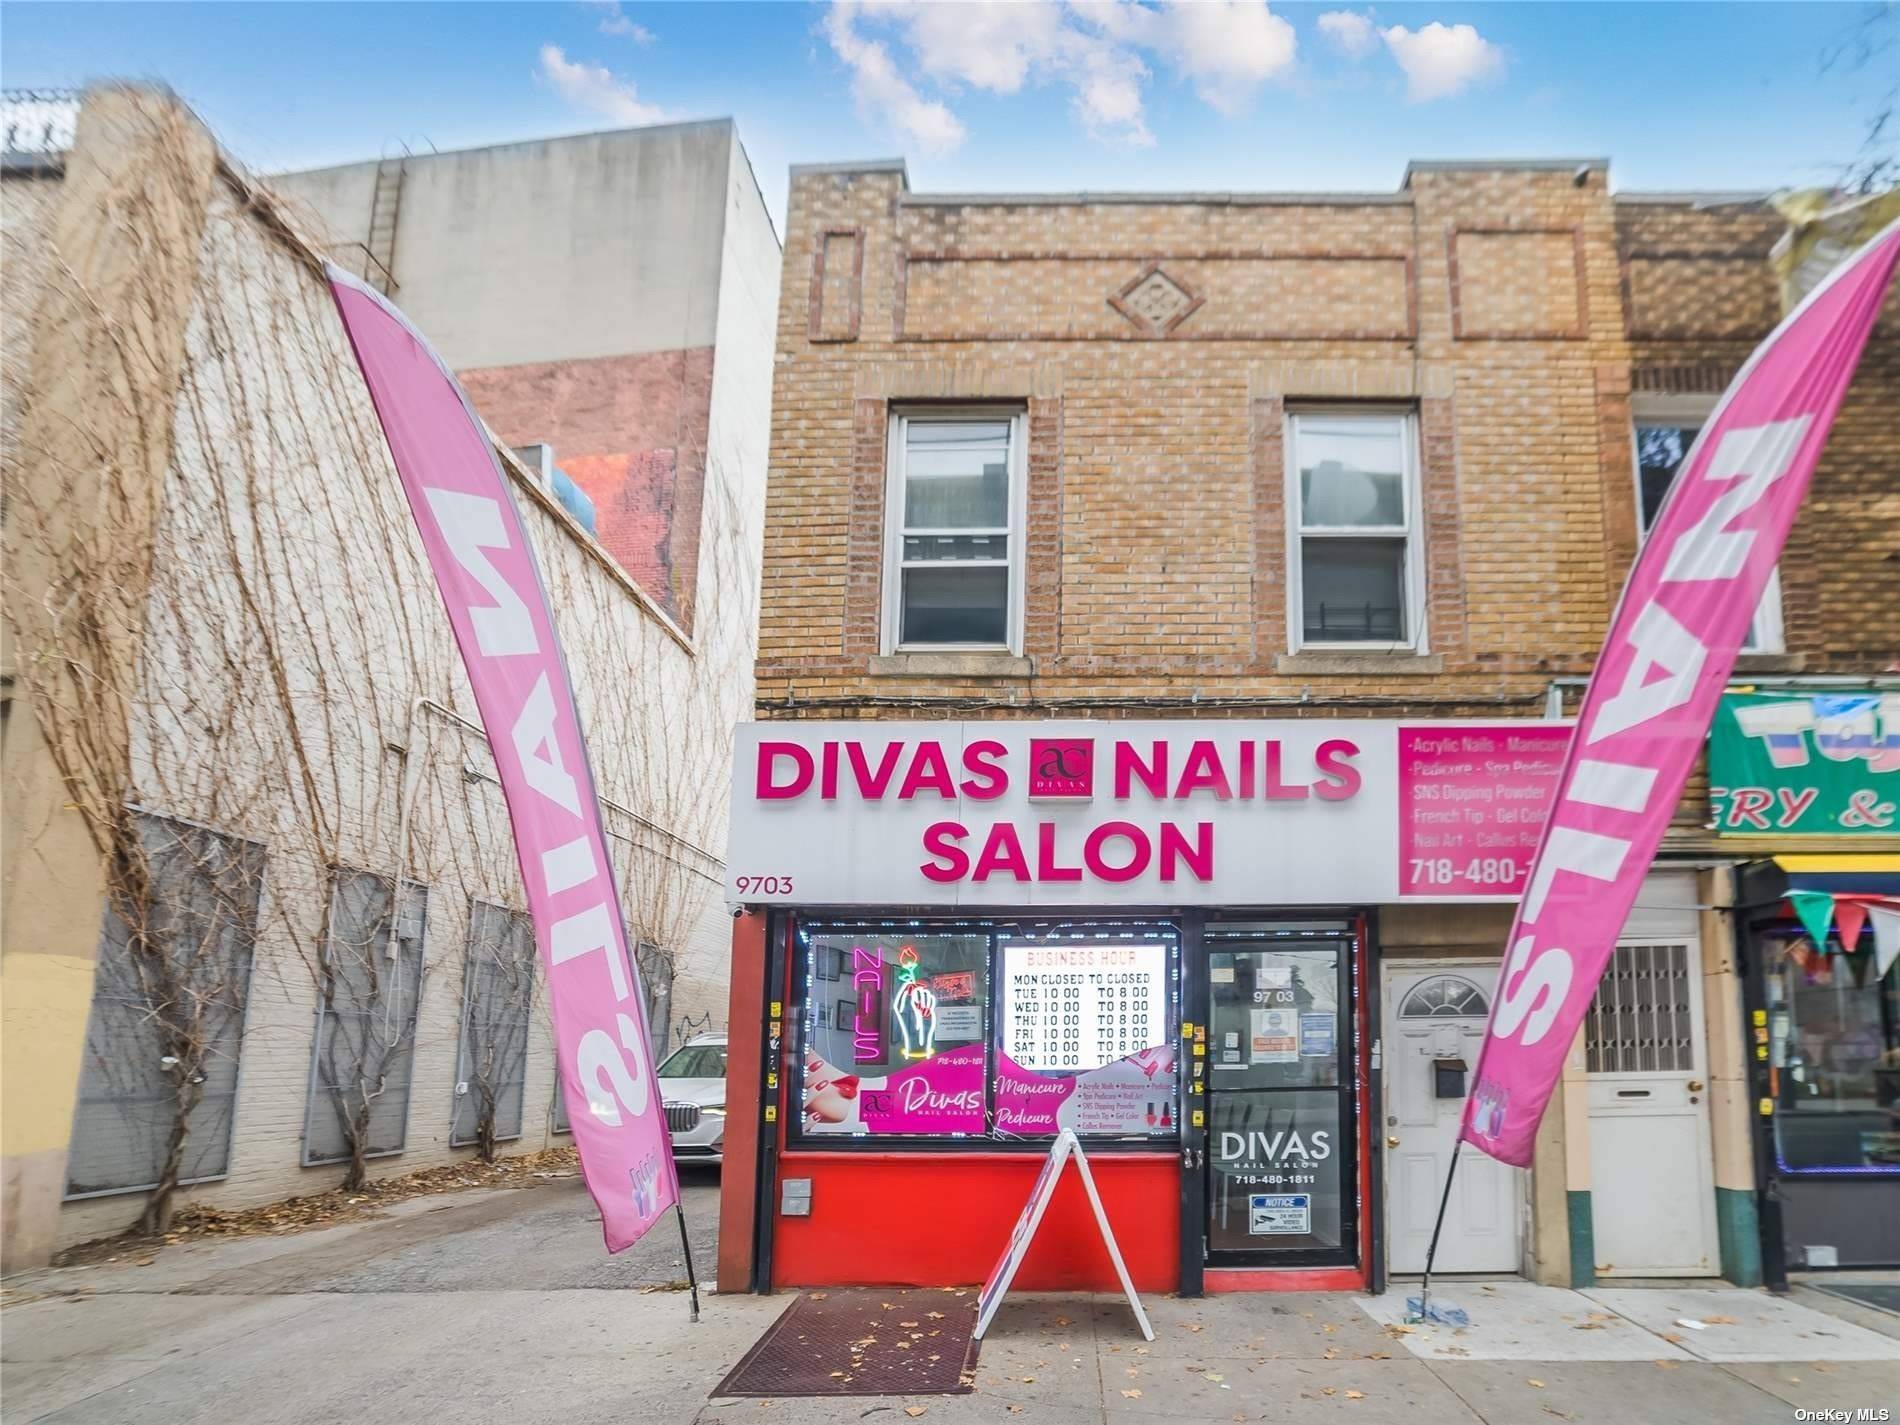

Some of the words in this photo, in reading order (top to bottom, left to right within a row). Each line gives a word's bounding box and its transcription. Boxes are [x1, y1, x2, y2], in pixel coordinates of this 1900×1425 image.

[1493, 413, 1813, 1046] NAILS
[755, 739, 1009, 801] DIVAS
[1114, 739, 1362, 801] NAILS
[1496, 785, 1546, 800] Powder
[1838, 789, 1897, 828] &
[919, 821, 1213, 883] SALON
[736, 876, 793, 896] 9703
[1027, 951, 1095, 966] BUSINESS
[1014, 975, 1038, 986] MON
[1041, 974, 1084, 985] CLOSED
[1089, 974, 1103, 985] TO
[1107, 973, 1150, 985] CLOSED
[1014, 988, 1037, 999] TUE
[1044, 988, 1058, 999] 10
[1063, 988, 1080, 999] 00
[1097, 987, 1114, 998] TO
[1120, 987, 1127, 998] 8
[1132, 987, 1148, 998] 00
[1253, 991, 1272, 1003] 97
[1276, 991, 1295, 1003] 03
[853, 946, 881, 1060] NAILS
[1014, 1002, 1039, 1012] WED
[1044, 1002, 1058, 1012] 10
[1063, 1002, 1080, 1012] 00
[1097, 1001, 1114, 1012] TO
[1120, 1001, 1127, 1012] 8
[1132, 1001, 1148, 1012] 00
[1014, 1015, 1038, 1026] THU
[1044, 1015, 1058, 1026] 10
[1063, 1015, 1080, 1026] 00
[1097, 1014, 1114, 1025] TO
[1120, 1014, 1127, 1025] 8
[1132, 1014, 1148, 1025] 00
[1015, 1029, 1033, 1039] FRI
[1044, 1029, 1058, 1039] 10
[1063, 1029, 1080, 1039] 00
[1097, 1028, 1114, 1038] TO
[1120, 1028, 1127, 1038] 8
[1132, 1028, 1148, 1038] 00
[1014, 1041, 1035, 1052] SAT
[1044, 1041, 1058, 1052] 10
[1063, 1041, 1080, 1052] 00
[1097, 1041, 1114, 1051] TO
[1120, 1041, 1127, 1051] 8
[1132, 1041, 1148, 1051] 00
[1013, 1055, 1035, 1065] SUN
[1043, 1055, 1057, 1065] 10
[1063, 1055, 1079, 1065] 00
[1097, 1054, 1113, 1065] TO
[996, 1075, 1066, 1096] Manicure
[899, 1076, 981, 1115] Divas
[997, 1107, 1053, 1127] Pedicure
[1221, 1131, 1330, 1161] DIVAS
[1235, 1175, 1315, 1184] 718-480-1811
[1265, 1198, 1296, 1207] NOTICE
